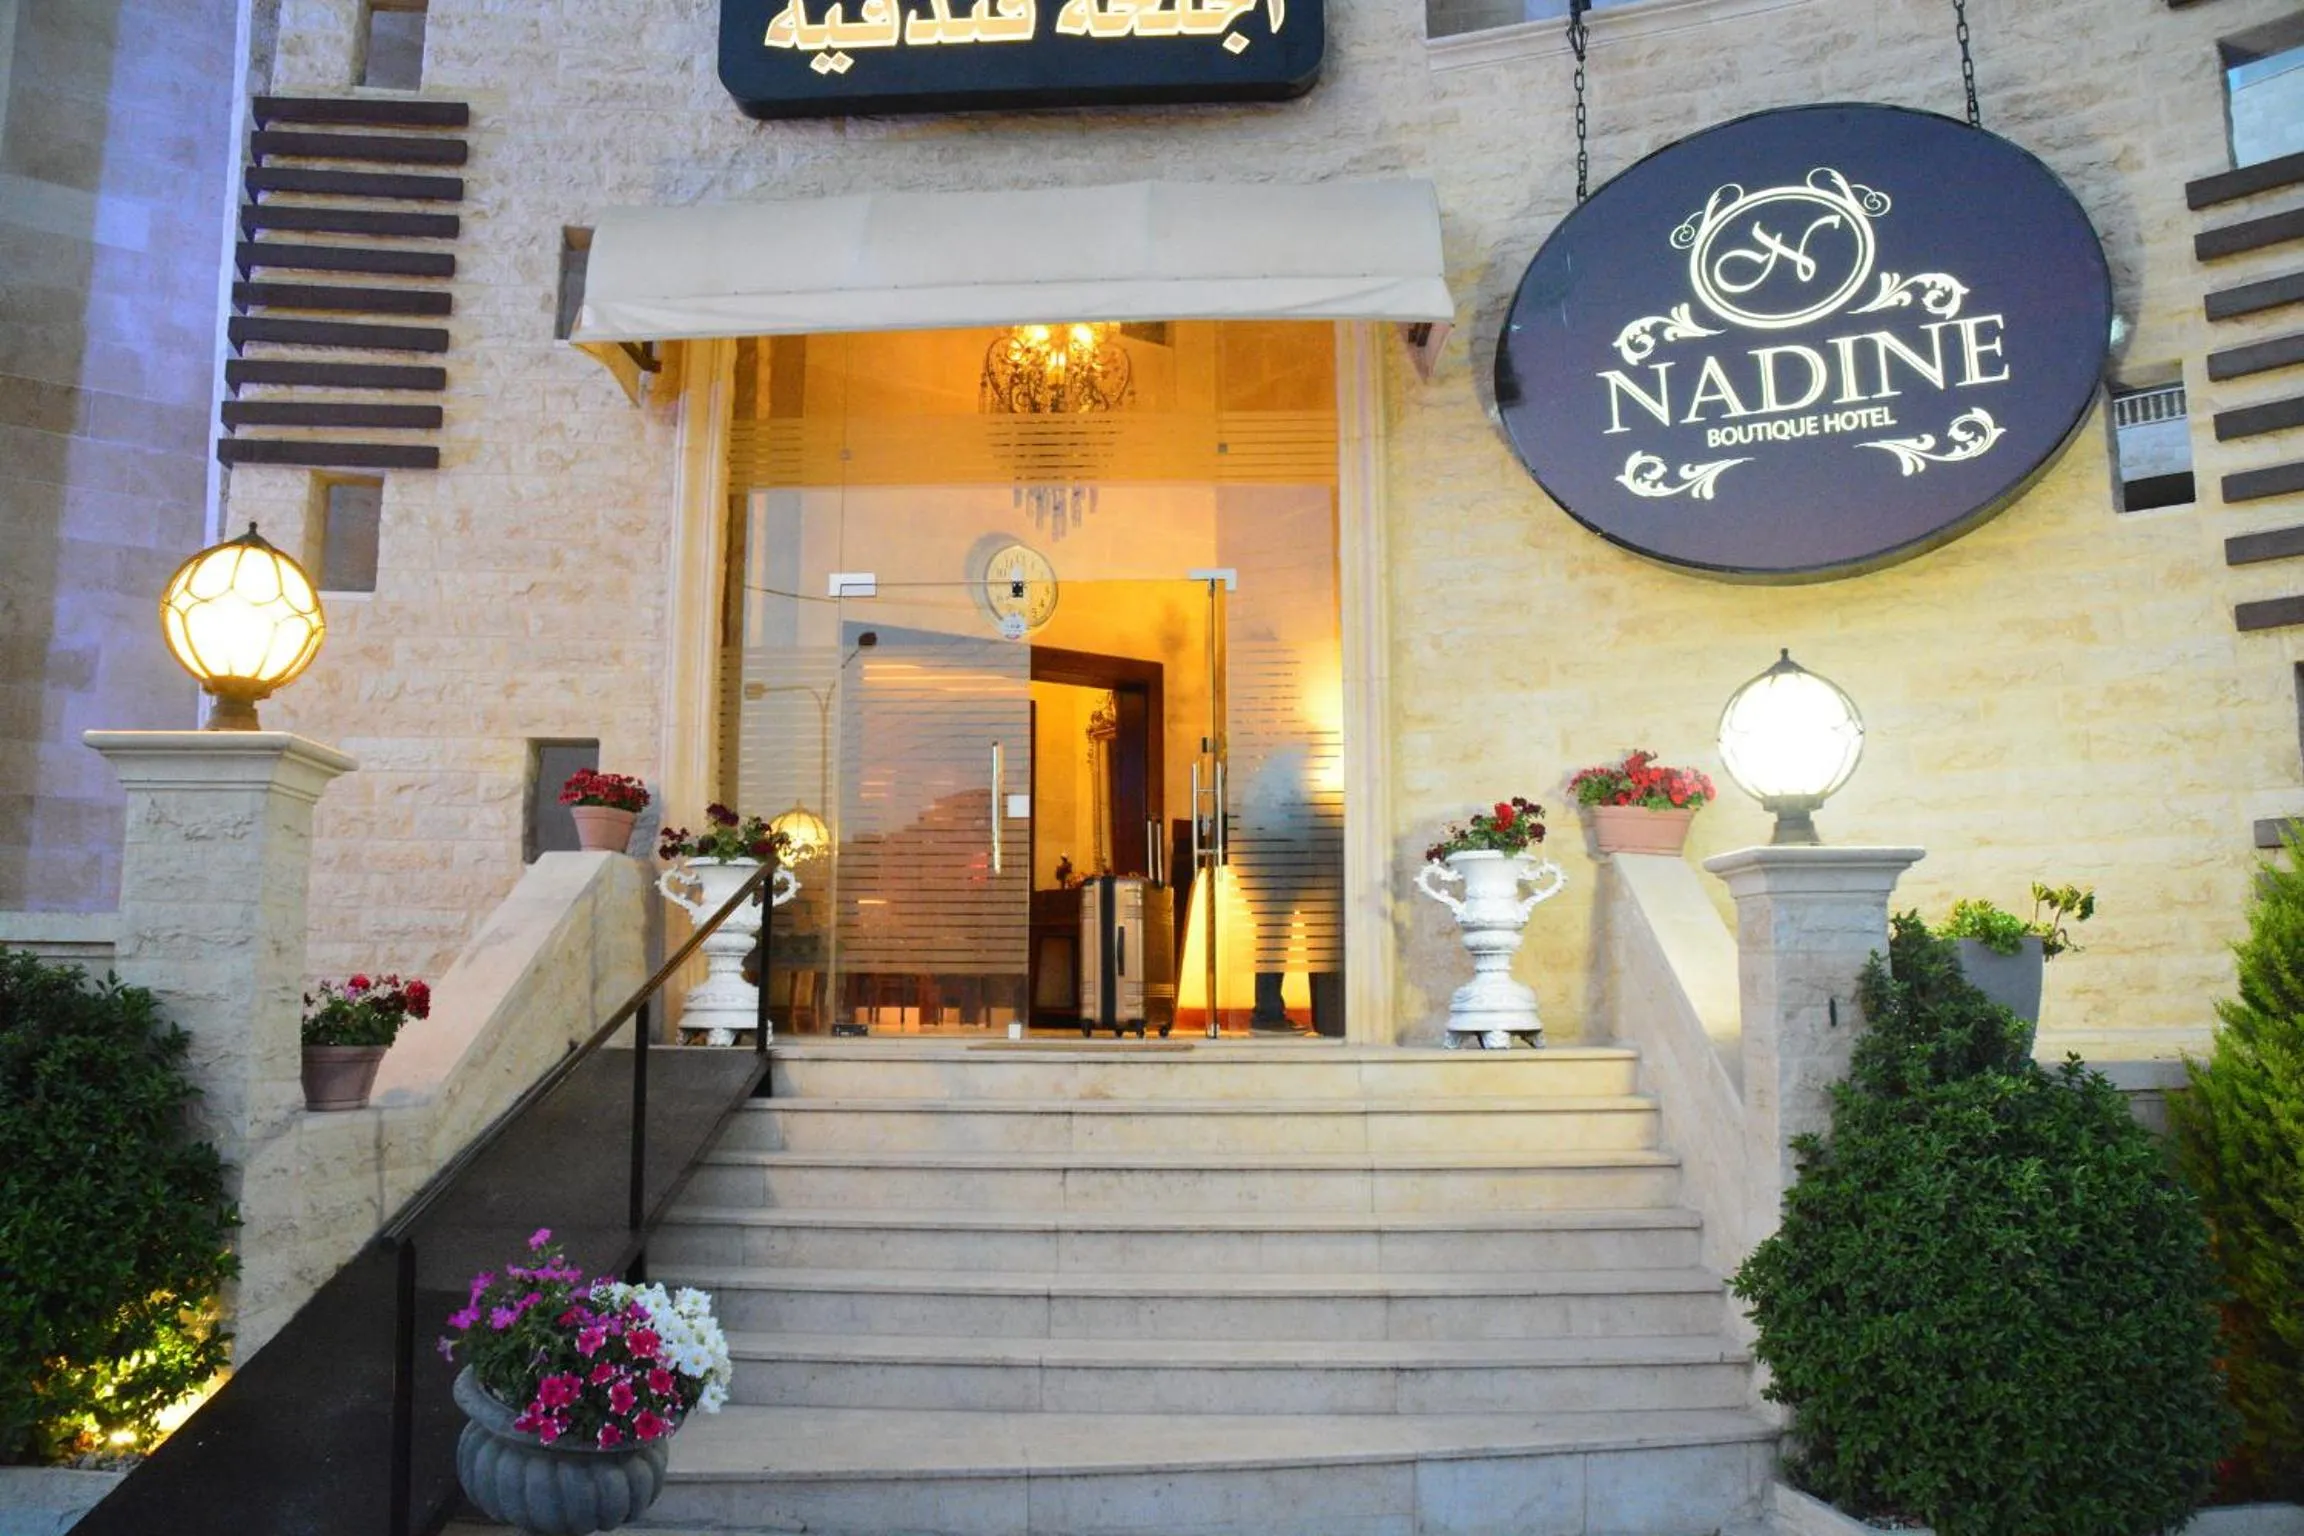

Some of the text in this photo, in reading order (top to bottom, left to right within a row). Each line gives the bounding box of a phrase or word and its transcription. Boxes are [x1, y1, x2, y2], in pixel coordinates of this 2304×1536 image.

[1596, 314, 2010, 434] NADINE
[1707, 406, 1898, 448] BOUTIQUE HOTEL
